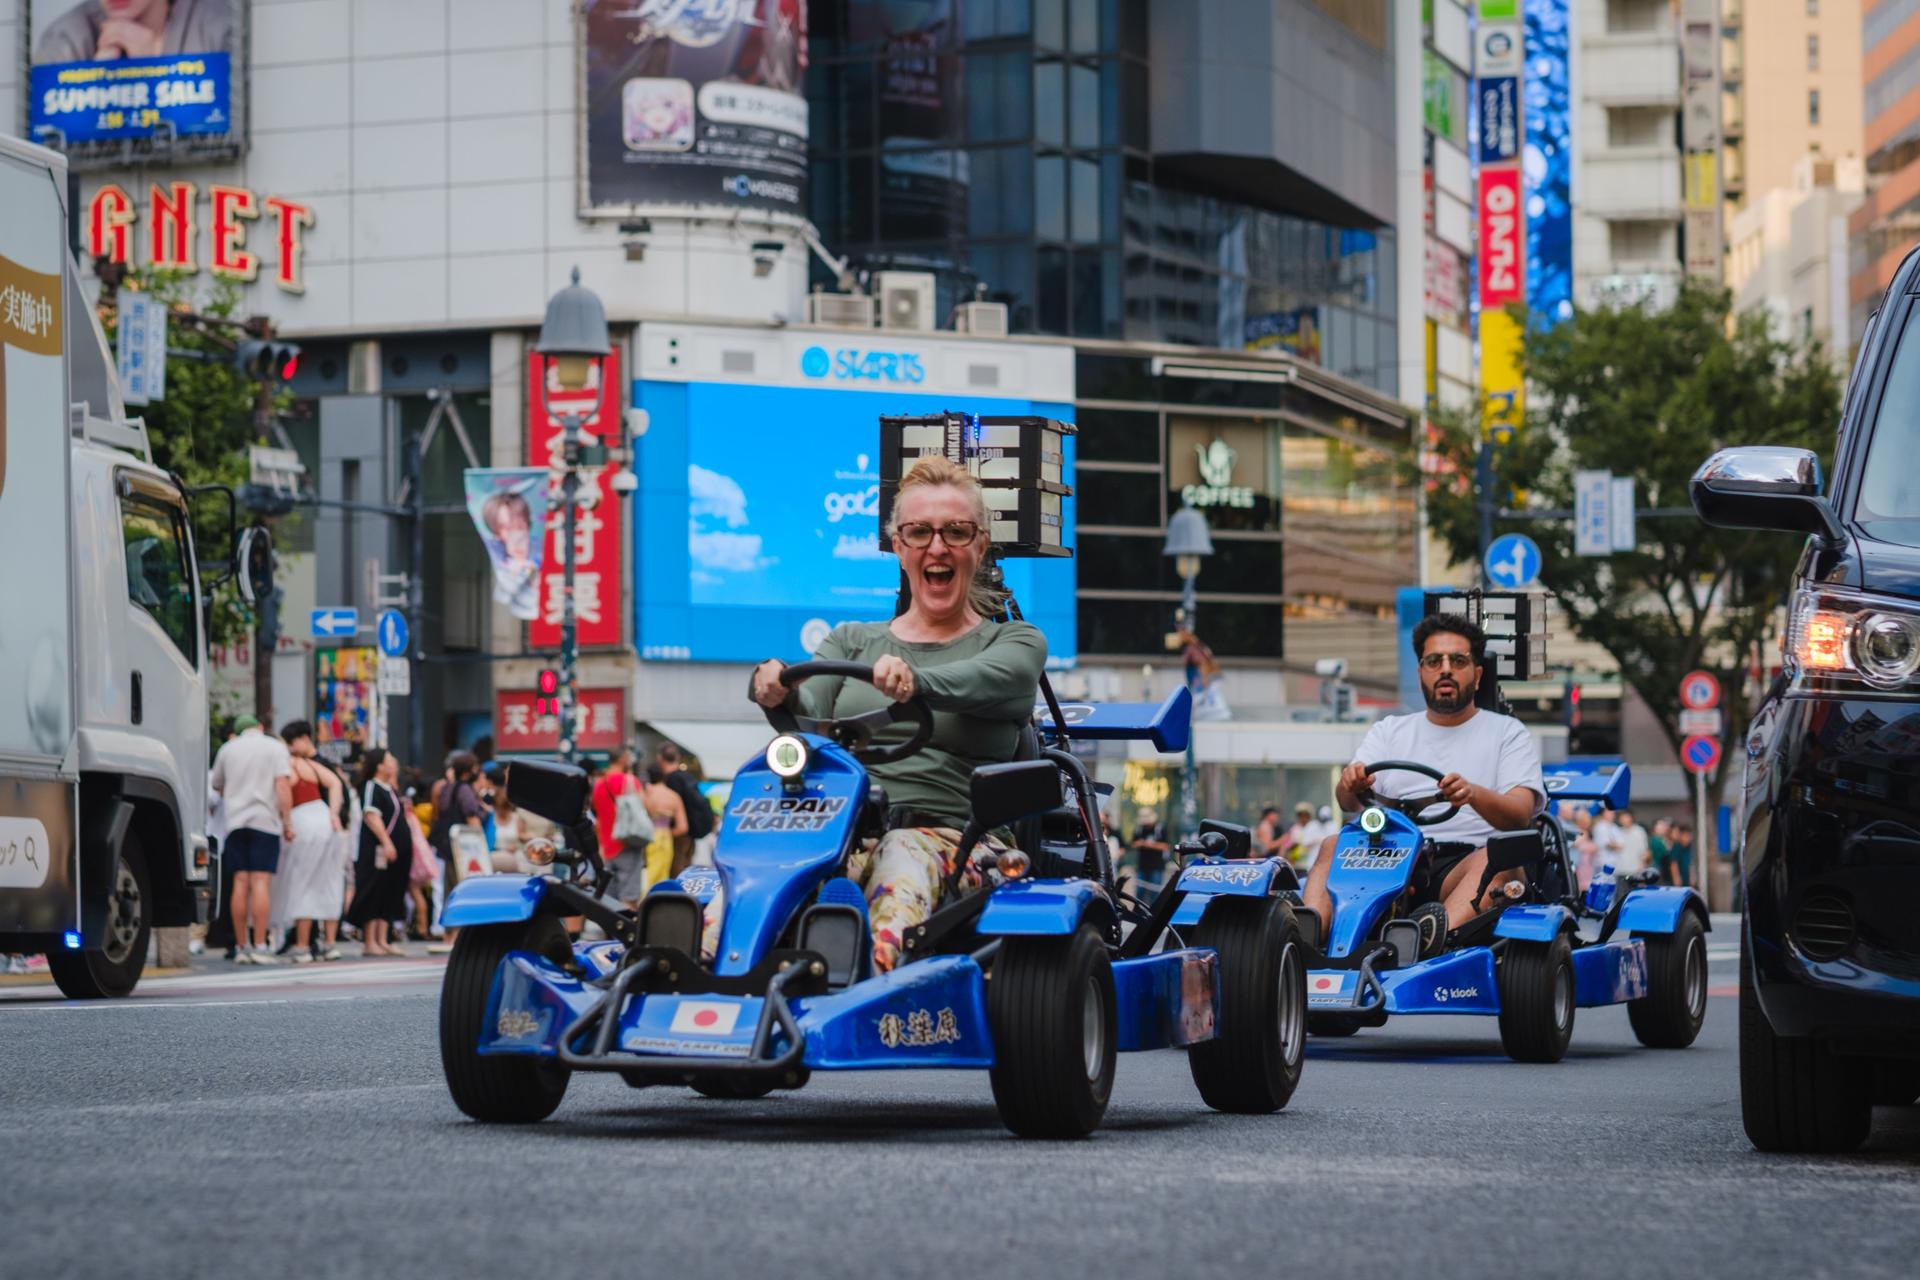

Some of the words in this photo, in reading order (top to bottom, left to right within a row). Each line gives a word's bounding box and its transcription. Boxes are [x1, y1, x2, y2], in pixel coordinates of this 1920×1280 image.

[44, 82, 149, 115] SUMMER
[155, 80, 215, 107] SALE
[0, 284, 53, 338] 実施中
[835, 347, 926, 383] STARTS
[1182, 484, 1255, 508] COFFEE
[729, 795, 849, 817] JAPAN
[735, 813, 836, 833] KART
[1338, 847, 1412, 860] JAPAN
[1342, 857, 1404, 870] KART
[1449, 986, 1478, 999] klook
[878, 1006, 962, 1049] 秋葉原
